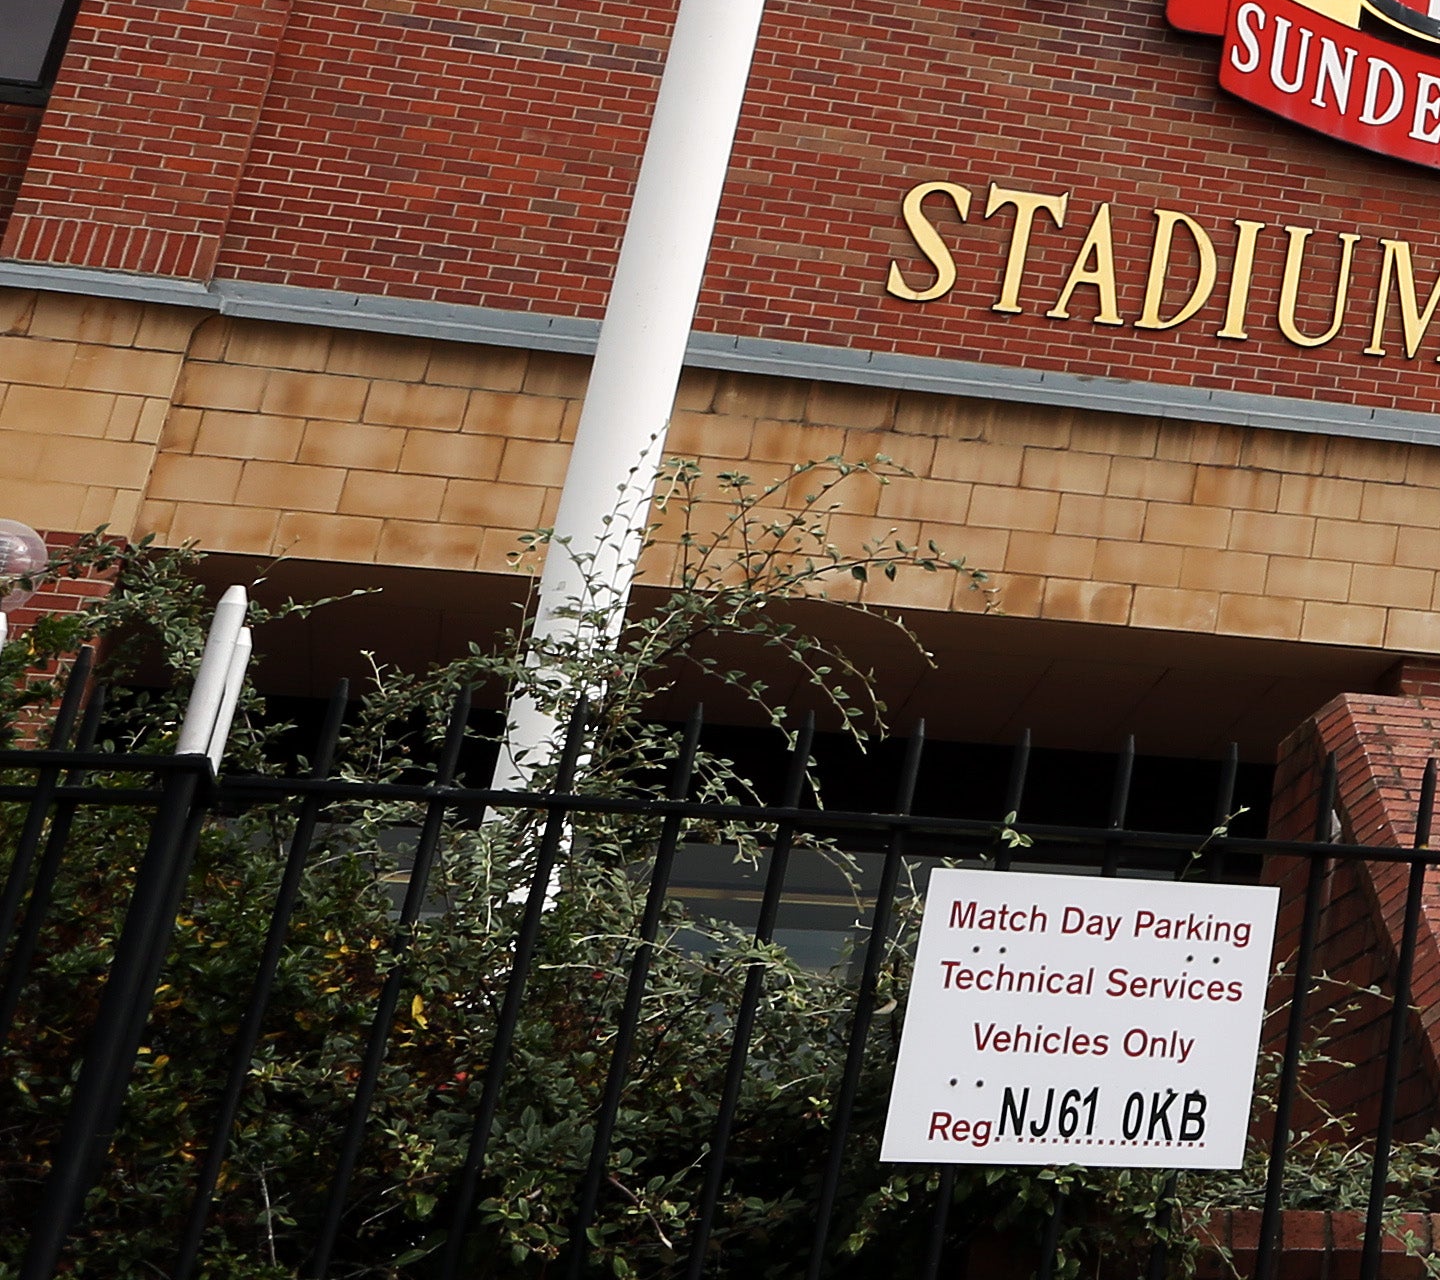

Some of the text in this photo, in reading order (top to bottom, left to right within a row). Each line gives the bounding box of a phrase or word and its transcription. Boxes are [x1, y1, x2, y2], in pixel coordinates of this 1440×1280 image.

[949, 900, 1252, 948] Match Day Parking
[940, 961, 1244, 1002] Technical Services
[973, 1023, 1195, 1063] Vehicles Only
[928, 1111, 992, 1148] Reg
[998, 1086, 1099, 1139] NJ61
